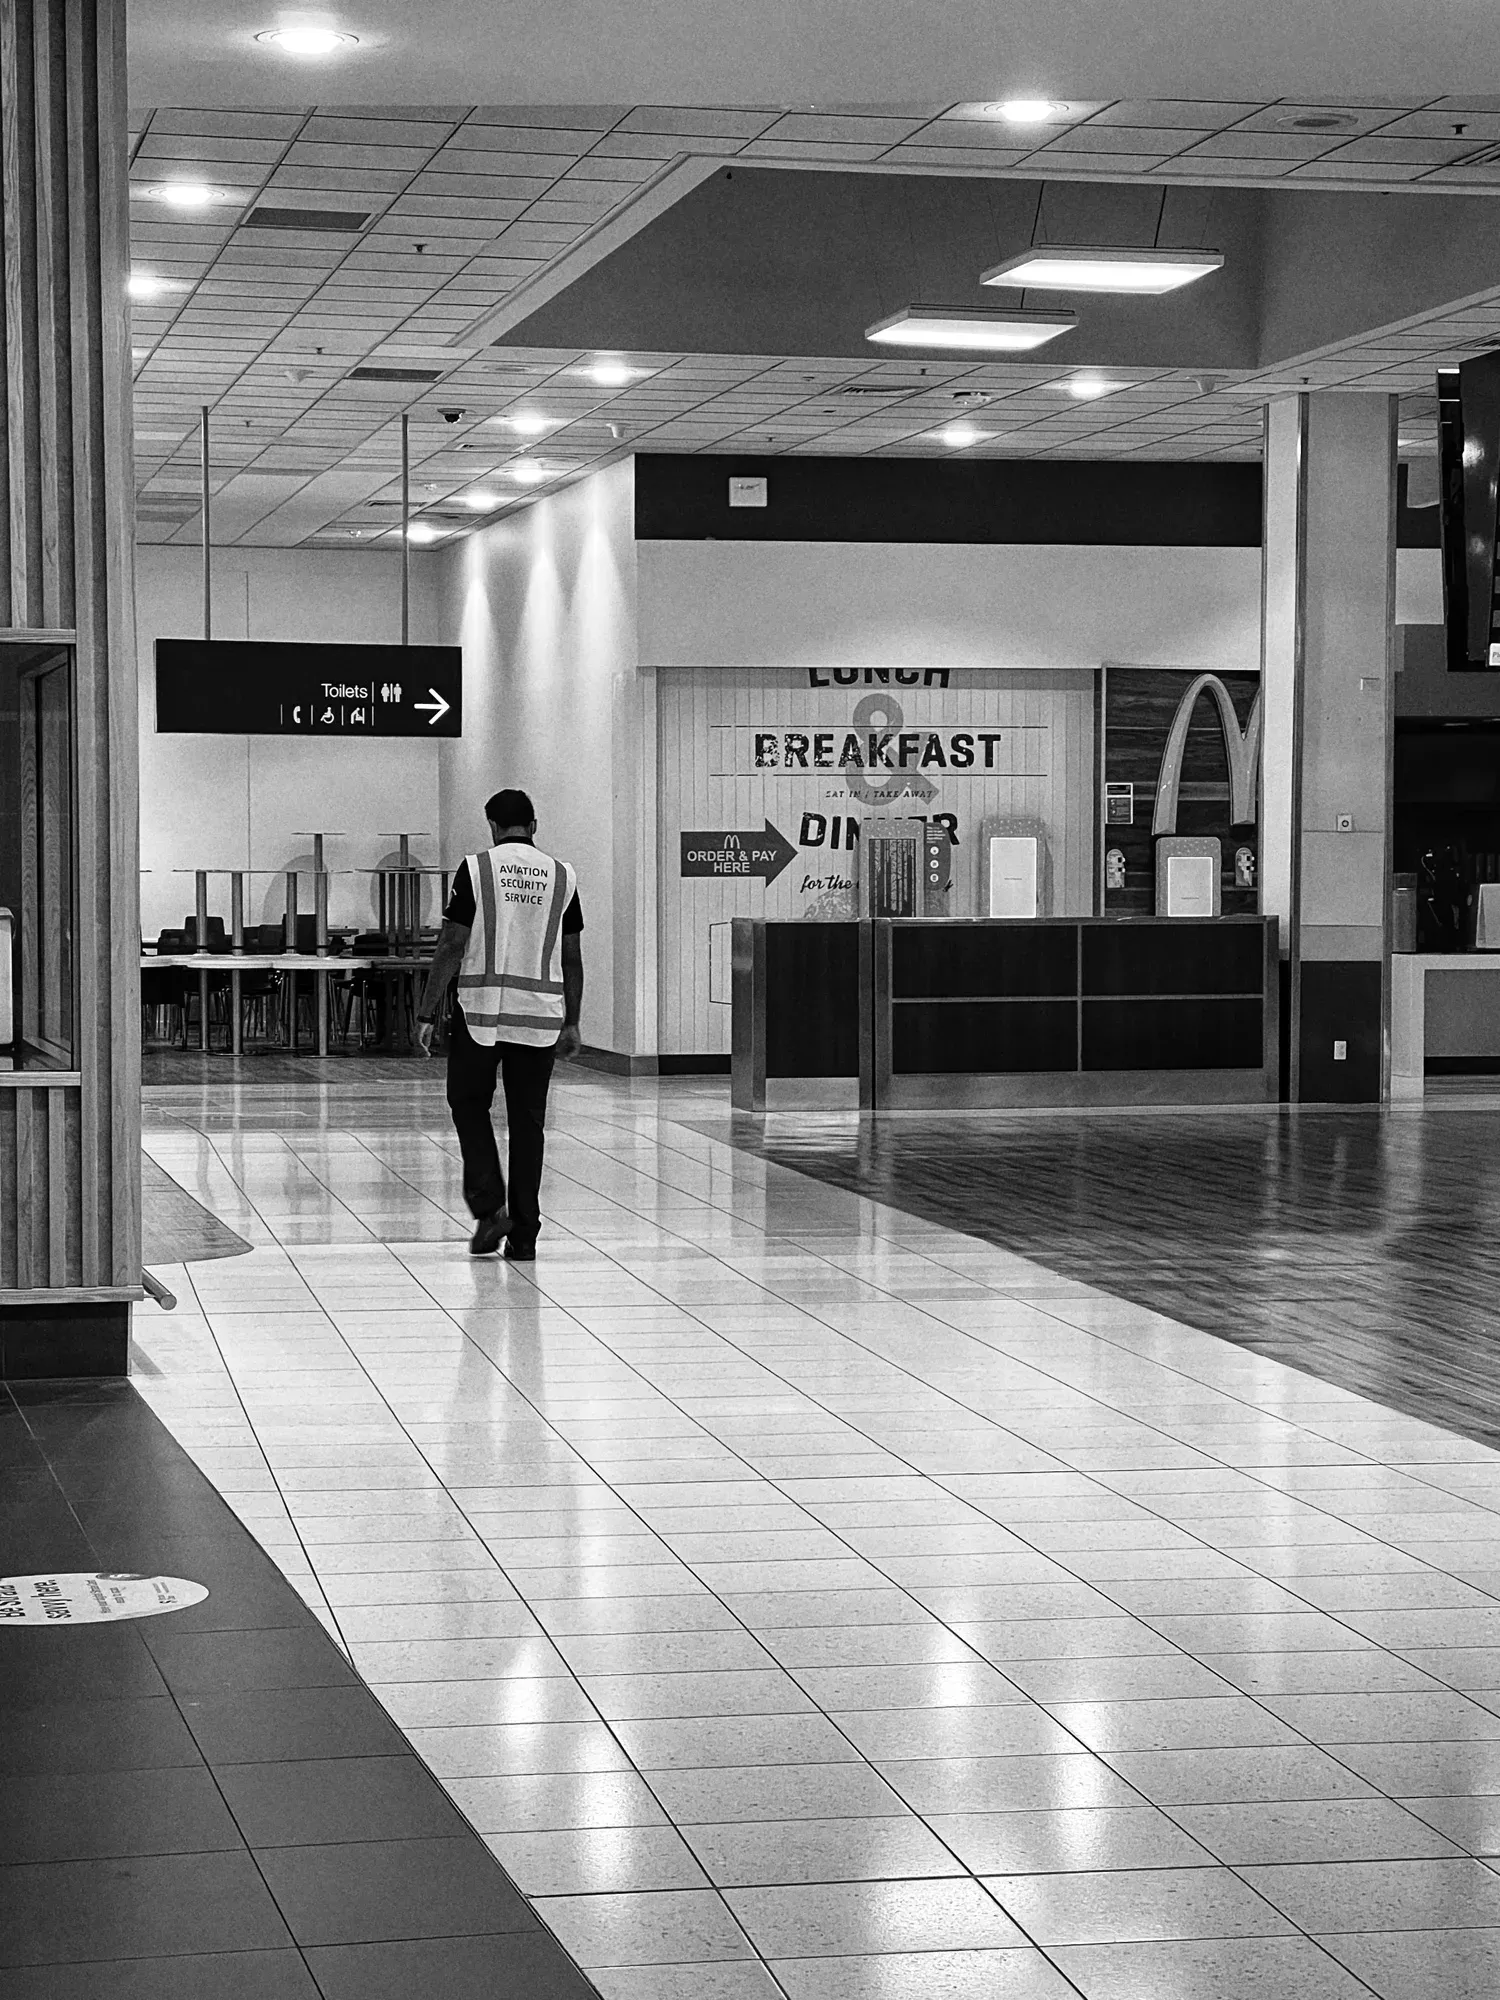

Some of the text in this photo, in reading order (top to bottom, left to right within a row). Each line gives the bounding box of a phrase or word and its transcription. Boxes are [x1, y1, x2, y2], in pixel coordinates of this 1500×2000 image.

[321, 683, 368, 698] Toilets
[755, 733, 1002, 768] BREAKFAST
[849, 790, 861, 798] IN
[874, 790, 899, 798] TAKE
[903, 790, 933, 798] AWAY
[687, 850, 777, 862] ORDER & PAY
[500, 864, 548, 878] AVIATION
[713, 862, 750, 873] HERE
[500, 878, 548, 891] SECURITY
[800, 874, 852, 893] for the
[505, 892, 543, 906] SERVICE
